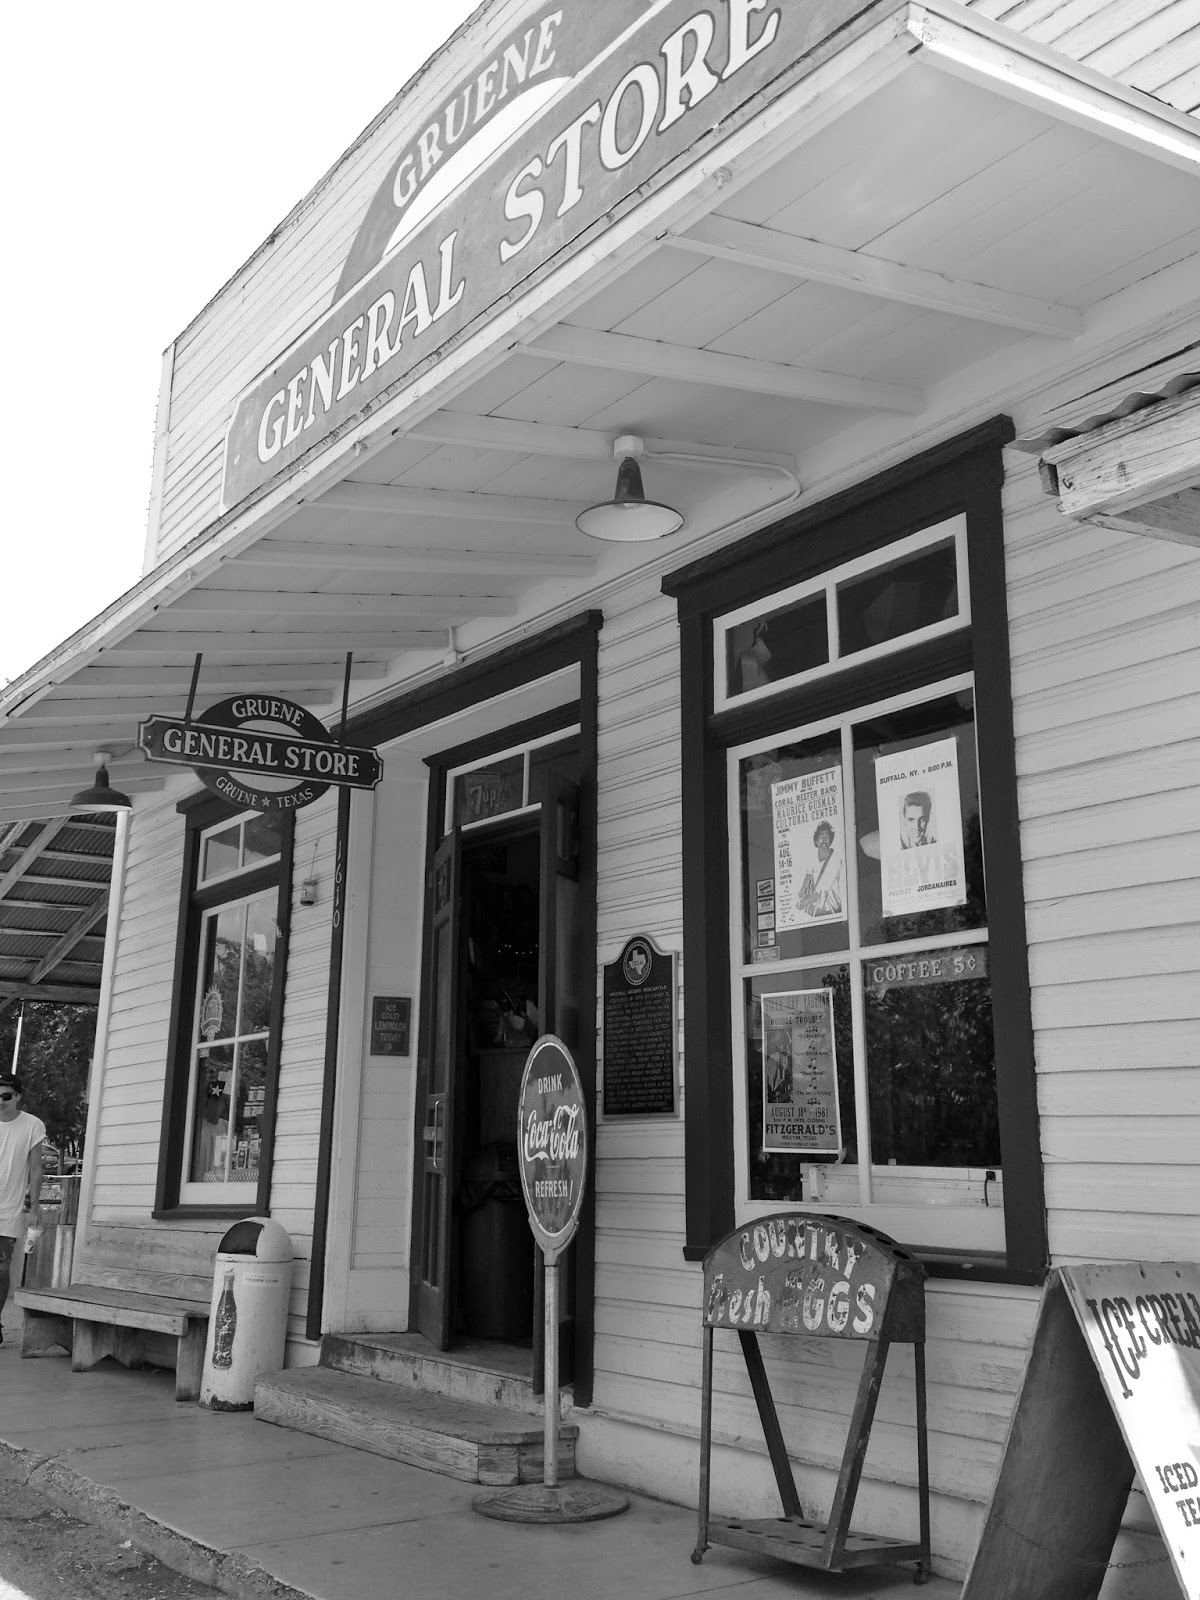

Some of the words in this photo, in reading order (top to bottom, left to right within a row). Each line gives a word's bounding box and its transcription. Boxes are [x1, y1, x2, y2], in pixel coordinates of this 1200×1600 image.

[392, 10, 564, 208] GRUENE
[255, 229, 466, 464] GENERAL
[498, 0, 782, 264] STORE
[231, 698, 305, 727] GRUENE
[163, 728, 279, 766] GENERAL
[284, 745, 360, 777] STORE
[776, 781, 799, 796] JIMMY
[801, 770, 836, 789] BUFFETT
[879, 772, 907, 785] BUFFALO,
[909, 768, 920, 778] NY.
[927, 763, 941, 773] 8:00
[216, 776, 258, 806] GRUENE
[275, 787, 314, 809] TEXAS
[774, 797, 794, 808] CORAL
[796, 790, 818, 803] REEFER
[820, 784, 838, 796] BAND
[775, 813, 809, 830] CULTURAL
[811, 805, 839, 821] CENTER
[777, 803, 806, 819] MAURICE
[808, 794, 836, 812] GUSMAN
[333, 839, 343, 928] 1610
[917, 879, 957, 893] JORDANAIRES
[873, 958, 943, 983] COFFEE
[381, 1011, 401, 1020] COLD
[385, 1004, 397, 1012] ICE
[374, 1021, 408, 1032] LEMONADE
[379, 1032, 402, 1043] TODAY
[537, 1073, 563, 1095] DRINK
[770, 1107, 795, 1118] AUGUST
[814, 1107, 829, 1118] 1981
[524, 1103, 580, 1163] Coca-Cola
[766, 1124, 837, 1136] FITZGERALD'S
[738, 1218, 868, 1280] COUNTRY
[1086, 1296, 1148, 1400] ICE
[1135, 1292, 1200, 1350] CREA
[1154, 1462, 1199, 1494] ICED
[1175, 1496, 1200, 1528] TE
